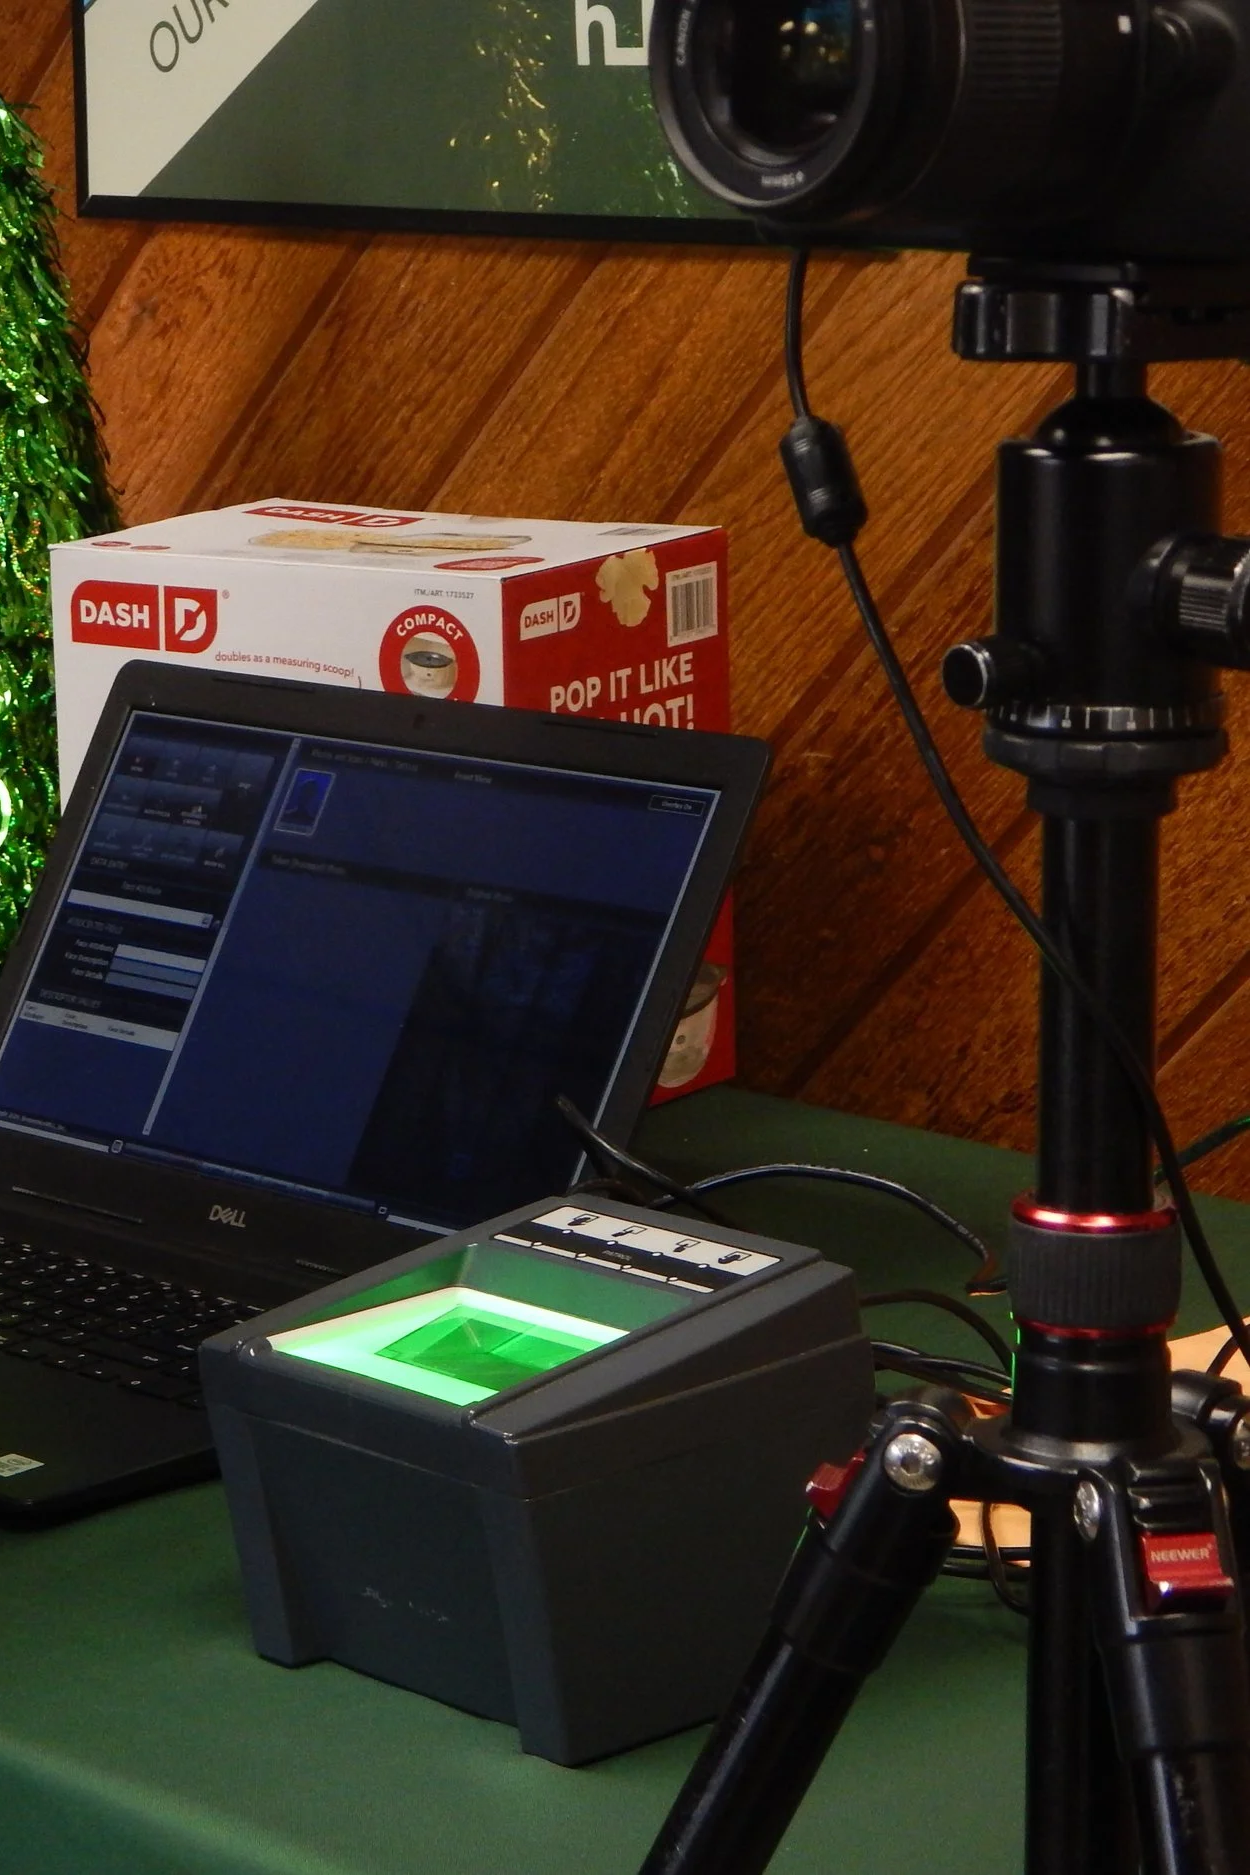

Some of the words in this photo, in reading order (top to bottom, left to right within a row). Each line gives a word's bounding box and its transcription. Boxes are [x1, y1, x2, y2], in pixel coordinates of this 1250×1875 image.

[79, 599, 150, 629] DASH
[396, 613, 464, 640] COMPACT
[524, 610, 555, 628] DASH
[215, 651, 251, 662] doubles
[253, 654, 263, 663] as
[273, 656, 321, 672] measuring
[323, 664, 355, 678] scoop!
[550, 676, 602, 713] POP
[609, 668, 632, 702] IT
[640, 652, 694, 694] LIKE
[209, 1204, 246, 1228] DELL
[1150, 1547, 1210, 1562] NEEWER
